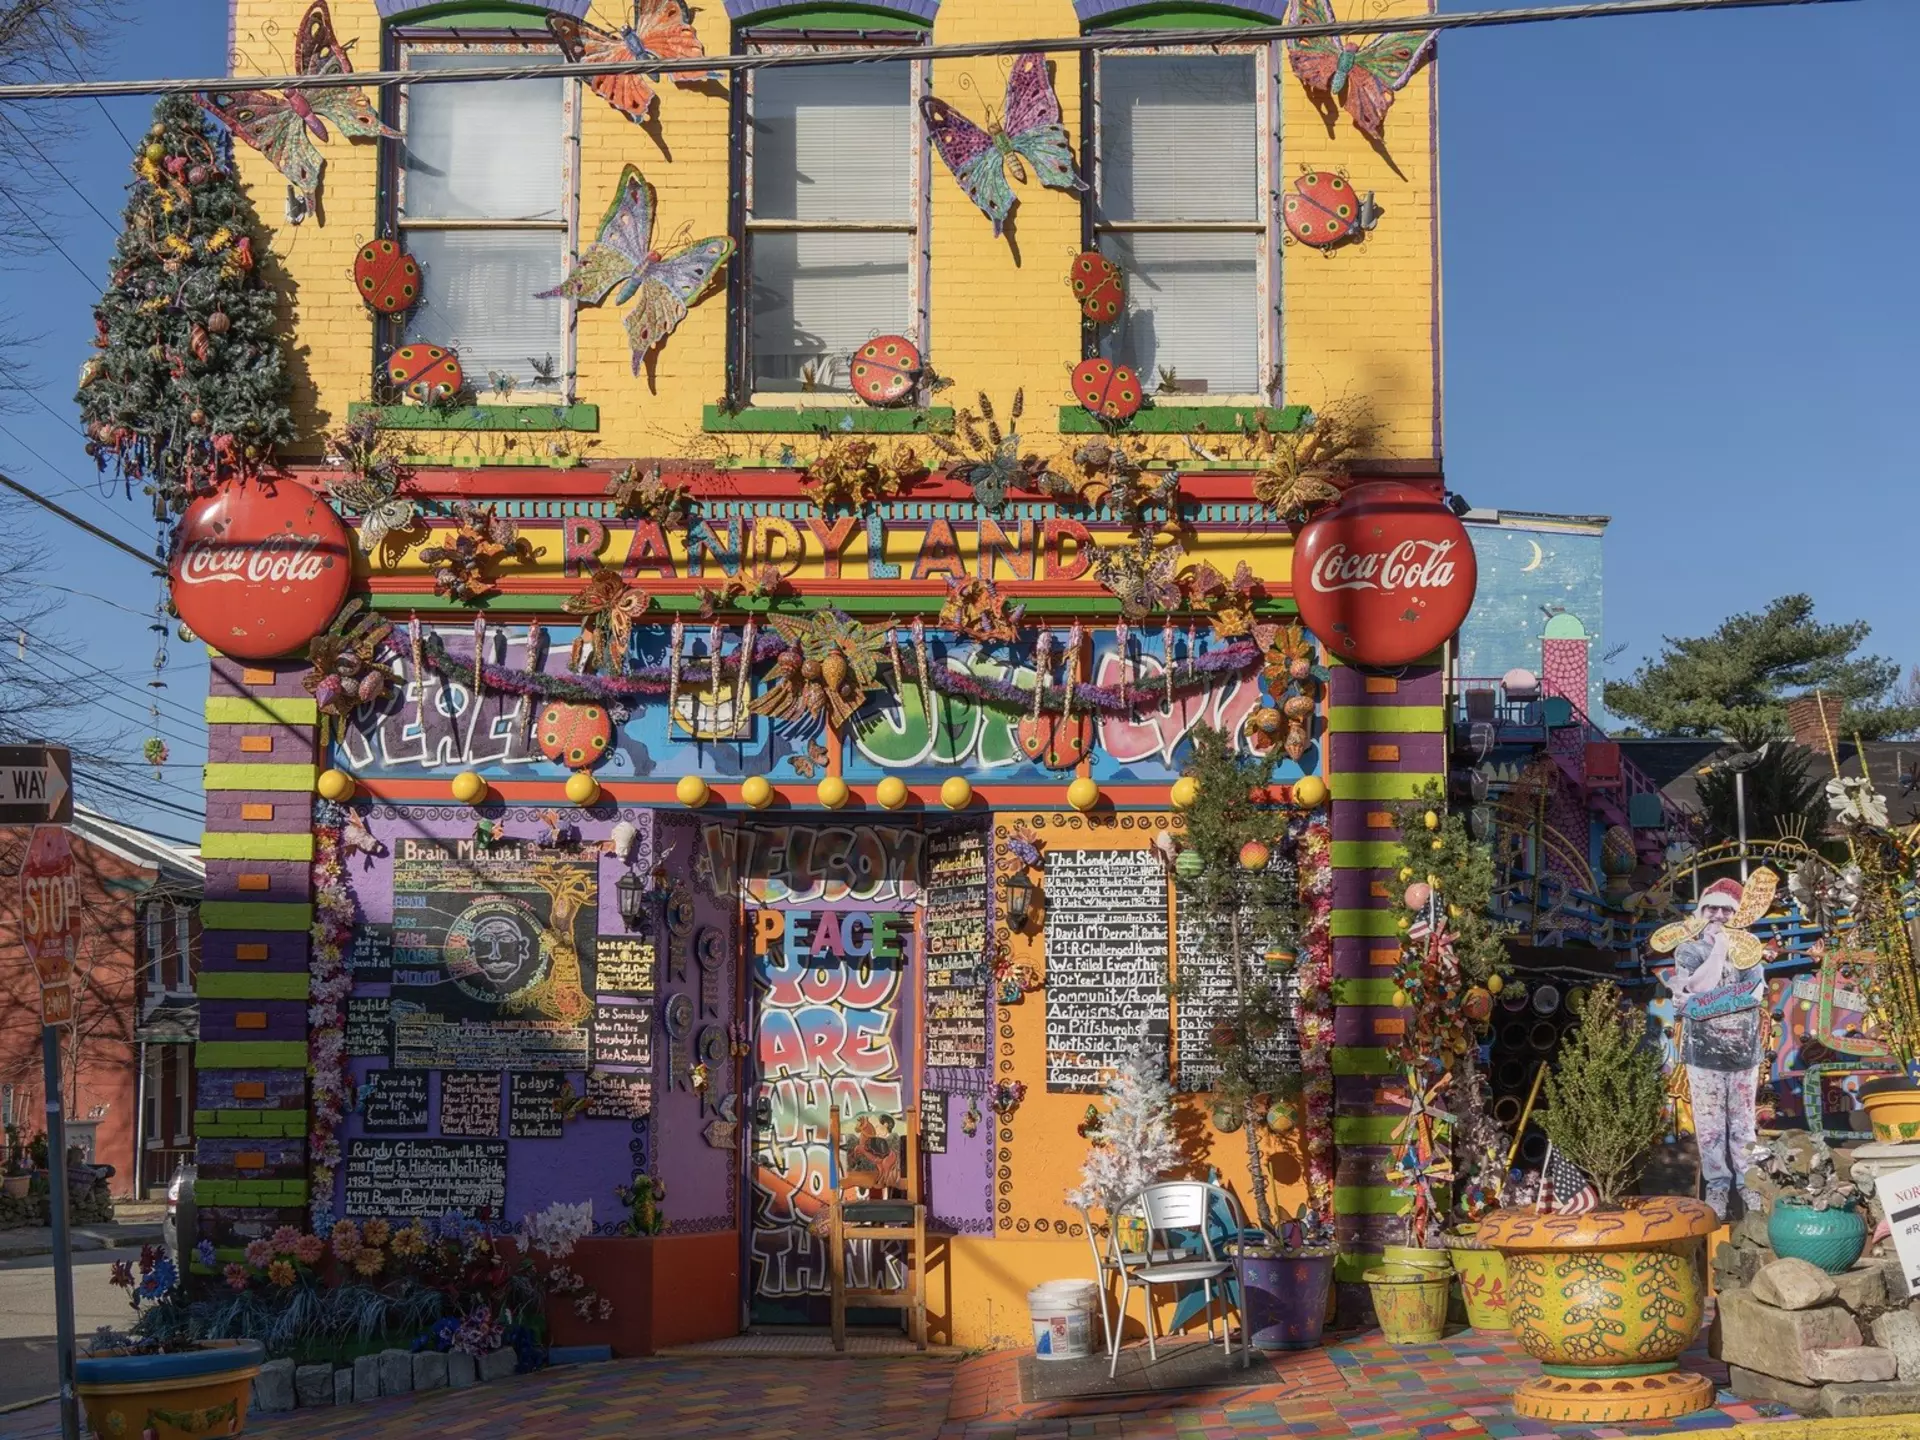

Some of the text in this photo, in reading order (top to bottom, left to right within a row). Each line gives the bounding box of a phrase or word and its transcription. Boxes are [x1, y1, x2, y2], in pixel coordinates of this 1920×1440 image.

[562, 514, 1096, 580] RANDYLAND
[1311, 538, 1458, 593] Coca-Cola
[12, 770, 48, 799] WAY
[405, 840, 450, 861] Brain
[1049, 850, 1135, 868] The Randyland
[1102, 887, 1138, 897] Gardens
[1141, 887, 1161, 897] And
[25, 875, 79, 935] STOP
[1125, 913, 1145, 923] Arch
[755, 911, 900, 957] PEACE
[1055, 925, 1084, 939] David
[1052, 957, 1073, 972] We
[1075, 957, 1103, 970] Failed
[598, 1008, 610, 1020] Be
[594, 1022, 613, 1033] Who
[1181, 1020, 1196, 1030] Do
[632, 1034, 649, 1045] Feel
[757, 1003, 894, 1077] ARE
[1181, 1031, 1196, 1041] Do
[611, 1048, 621, 1060] A
[1050, 1053, 1074, 1067] We
[1076, 1053, 1101, 1067] Can
[369, 1074, 381, 1086] If
[382, 1078, 400, 1089] you
[1050, 1069, 1100, 1090] Respect
[367, 1103, 389, 1115] your
[510, 1124, 523, 1136] Be
[352, 1142, 393, 1161] Randy
[409, 1158, 448, 1173] Historic
[347, 1176, 373, 1187] 1982
[346, 1191, 370, 1203] 1994
[401, 1188, 450, 1209] Randyland
[1894, 1185, 1920, 1204] NOR
